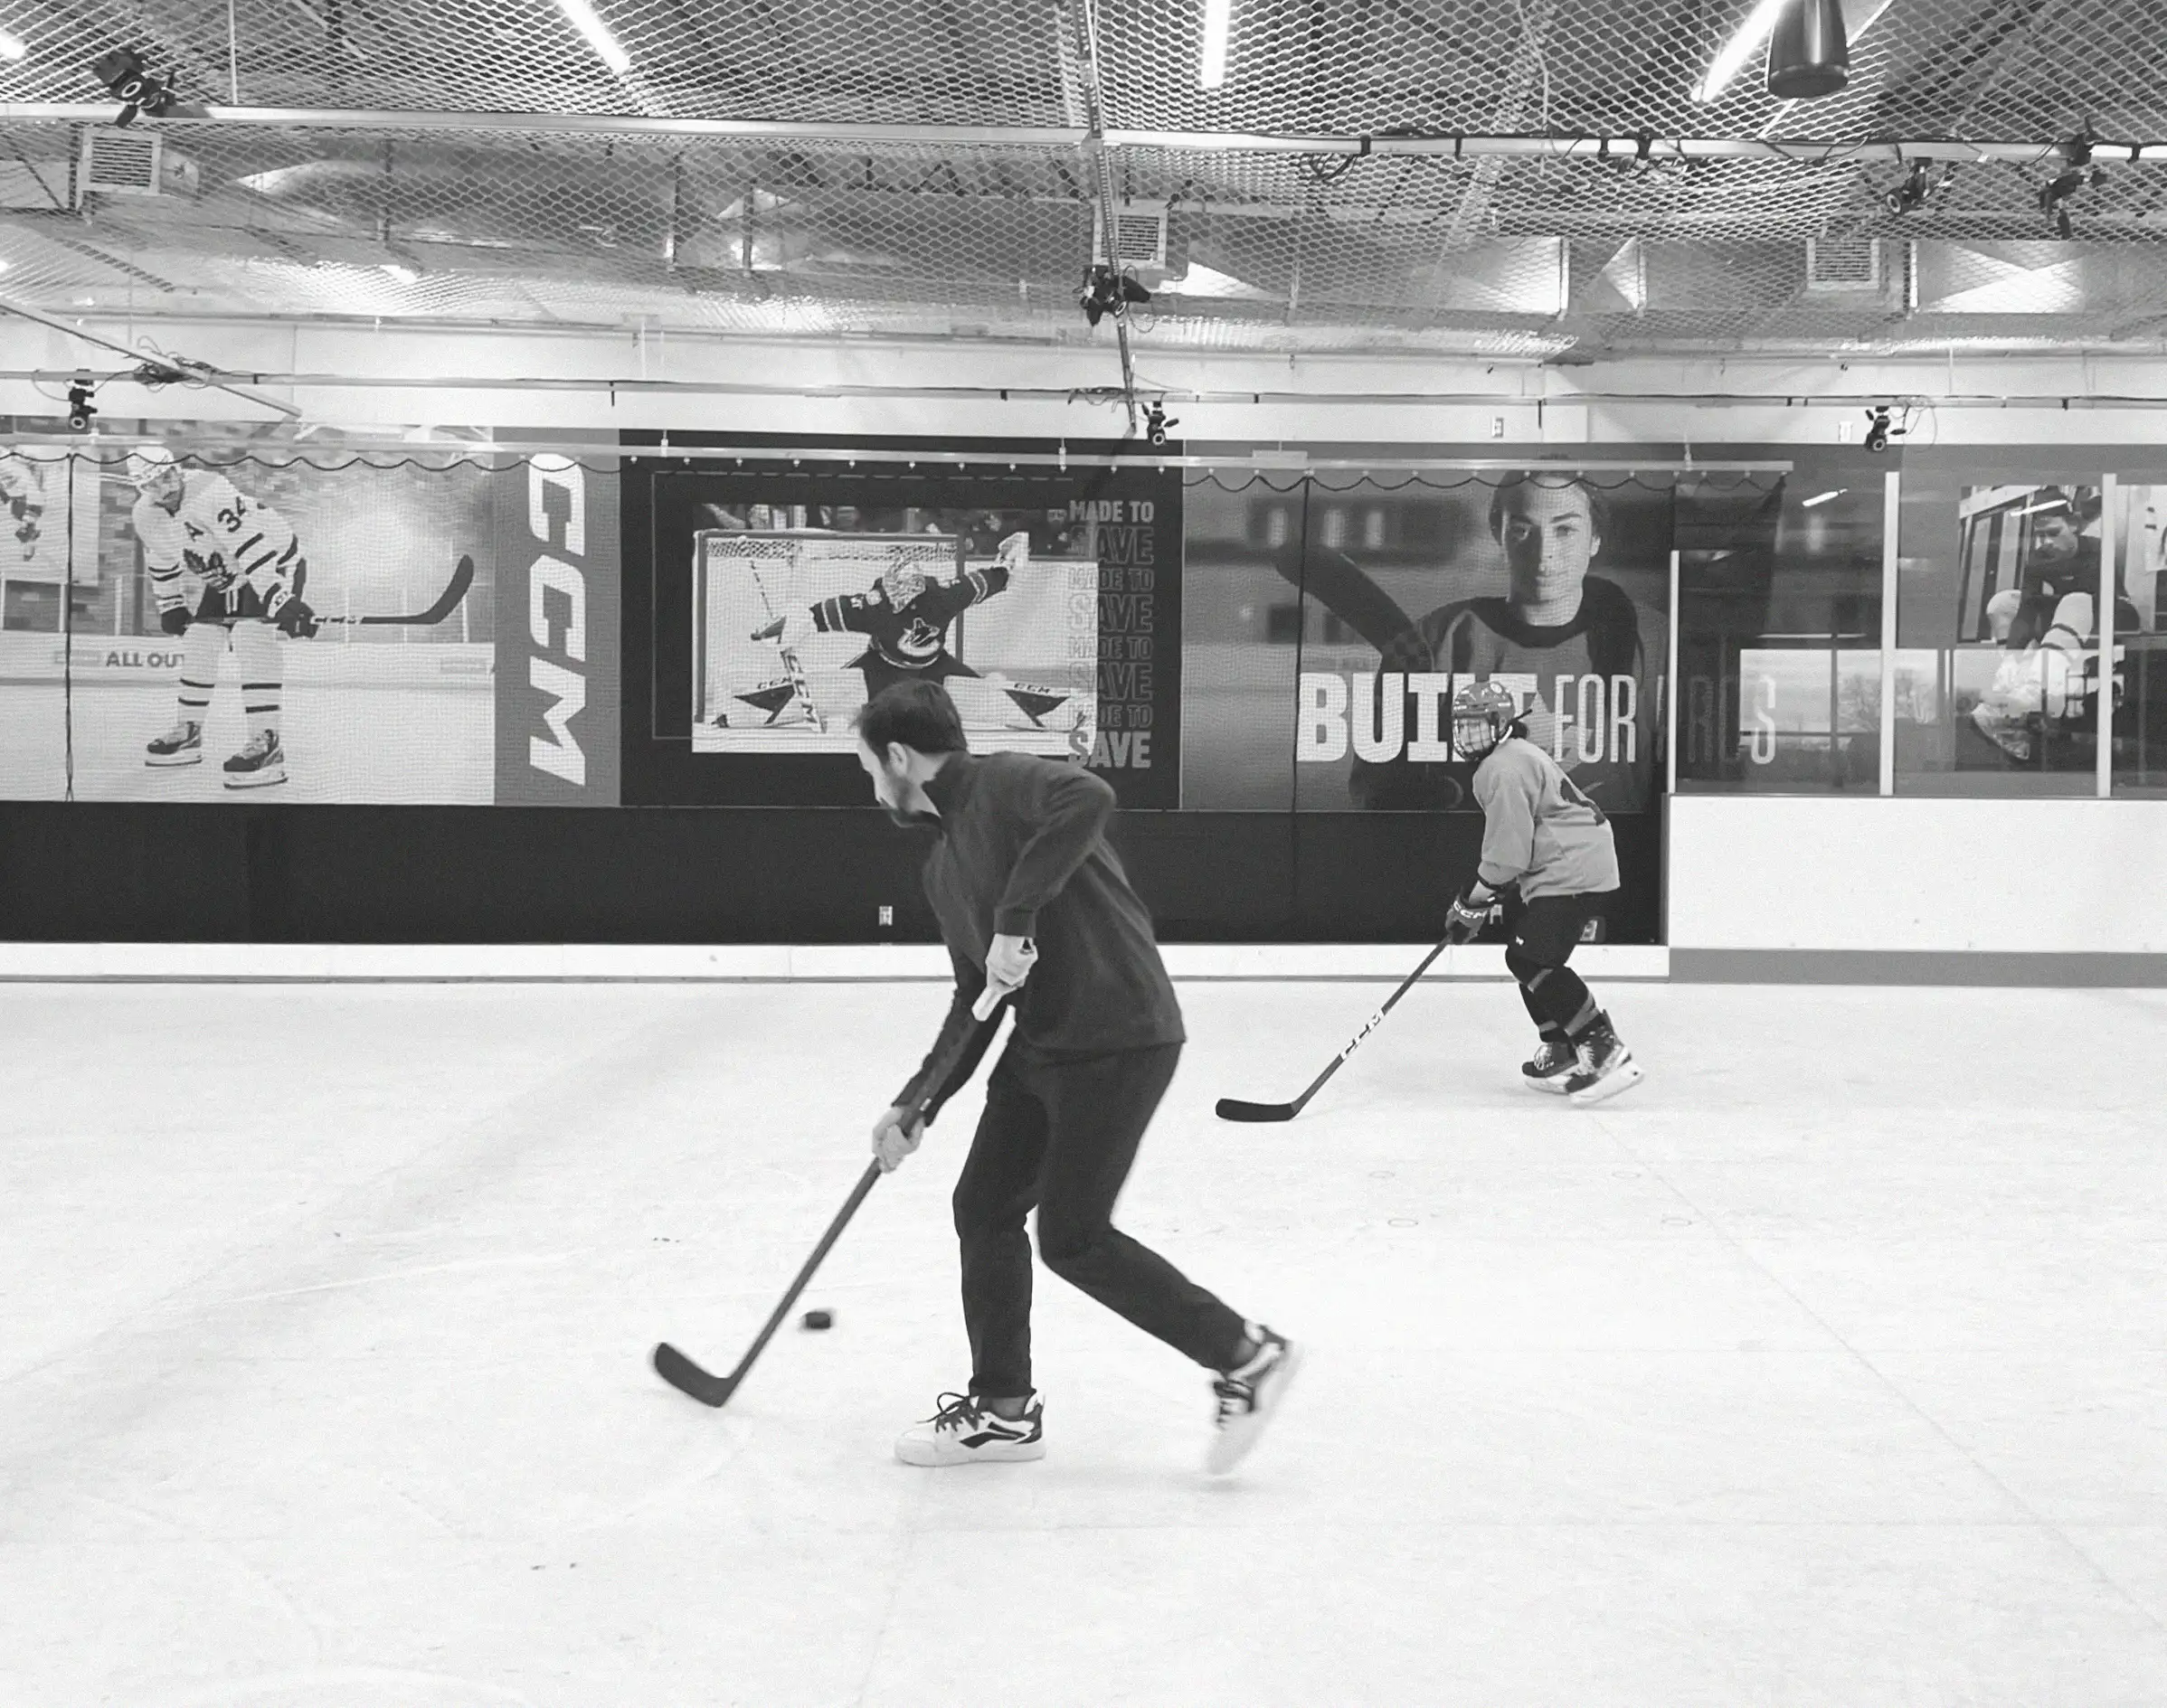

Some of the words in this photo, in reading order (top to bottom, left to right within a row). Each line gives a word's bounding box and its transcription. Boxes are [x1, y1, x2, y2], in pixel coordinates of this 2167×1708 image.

[1069, 500, 1123, 522] MADE
[1129, 501, 1155, 523] TO
[1128, 568, 1155, 591] TO
[529, 453, 585, 786] CCM
[1069, 593, 1153, 633] SAVE
[106, 650, 143, 667] ALL
[1127, 637, 1153, 660] TO
[1127, 703, 1153, 728] TO
[1555, 674, 1636, 763] FOR
[1068, 731, 1151, 768] SAVE
[1453, 900, 1488, 920] CCM
